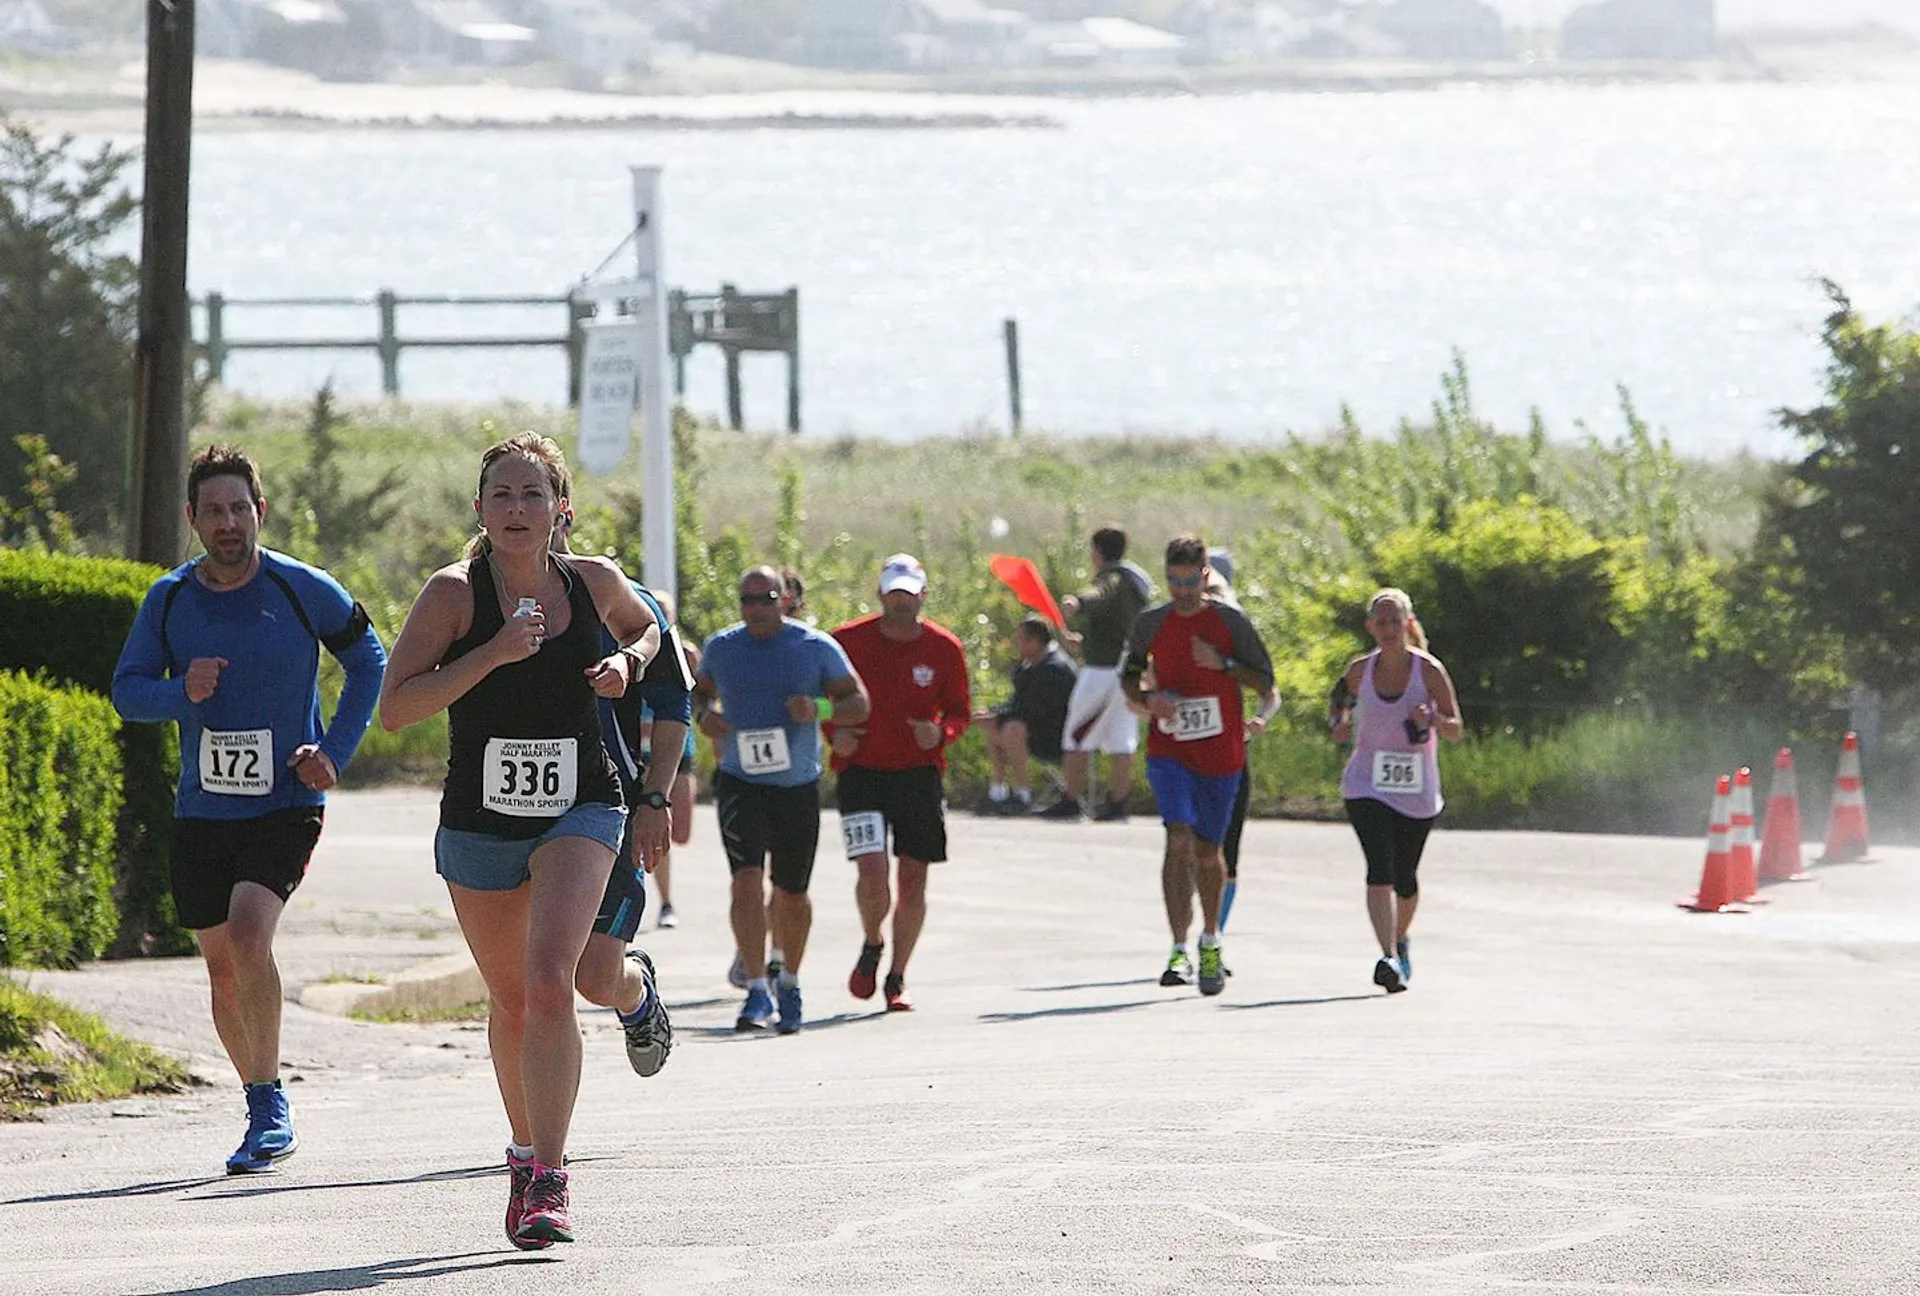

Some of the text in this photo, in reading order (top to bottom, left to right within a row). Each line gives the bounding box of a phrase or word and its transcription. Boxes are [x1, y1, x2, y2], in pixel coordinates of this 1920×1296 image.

[1180, 708, 1211, 730] 507
[502, 742, 561, 751] JOHNNY KELLEY
[752, 743, 773, 763] 14
[211, 749, 260, 778] 172
[1382, 764, 1414, 782] 506
[500, 760, 559, 796] 336
[489, 795, 569, 808] MARATHON SPORTS
